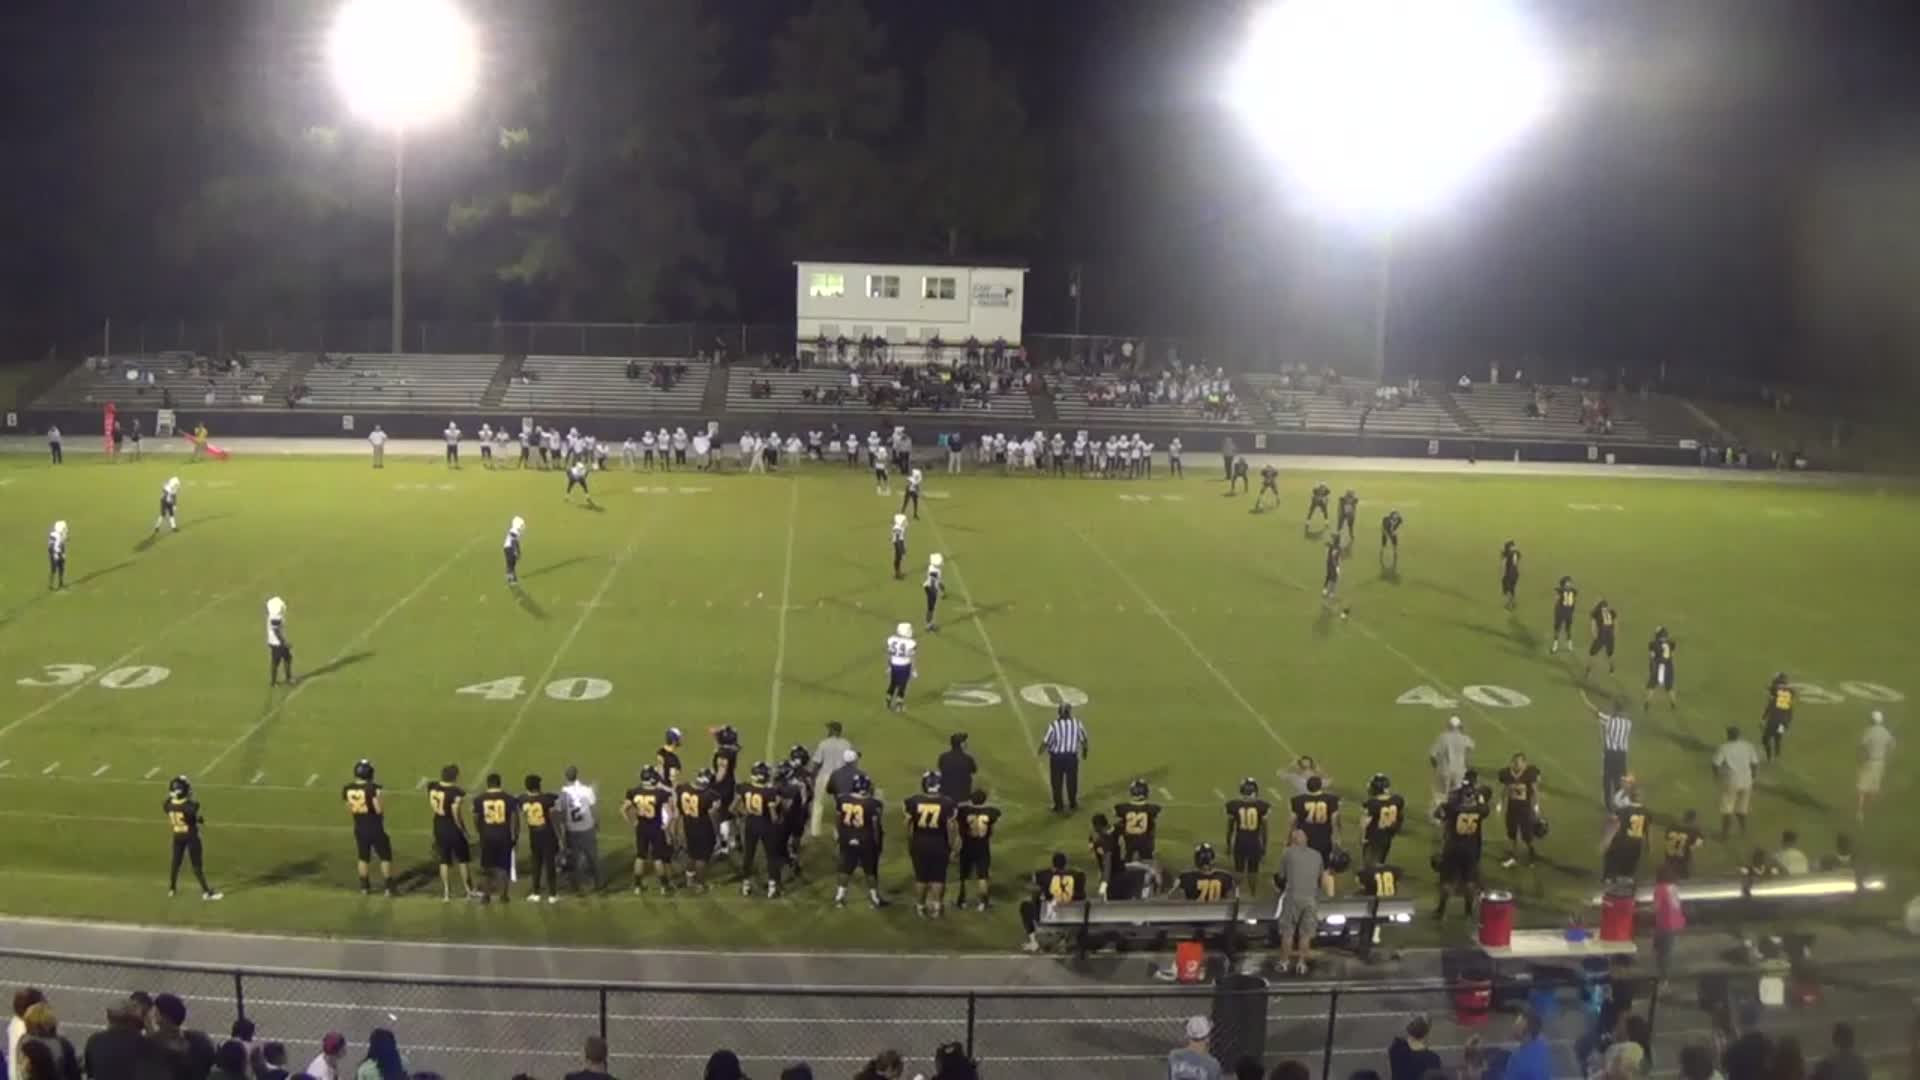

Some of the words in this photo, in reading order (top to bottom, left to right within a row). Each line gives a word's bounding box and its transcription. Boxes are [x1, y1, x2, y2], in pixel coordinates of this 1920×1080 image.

[16, 663, 171, 689] 30
[455, 675, 613, 701] 40
[942, 682, 1089, 708] 50
[1396, 683, 1531, 710] 40
[483, 798, 506, 824] 50
[841, 803, 865, 828] 73
[917, 803, 941, 829] 77
[1125, 811, 1148, 835] 23
[1238, 806, 1258, 831] 10
[1049, 874, 1074, 903] 43
